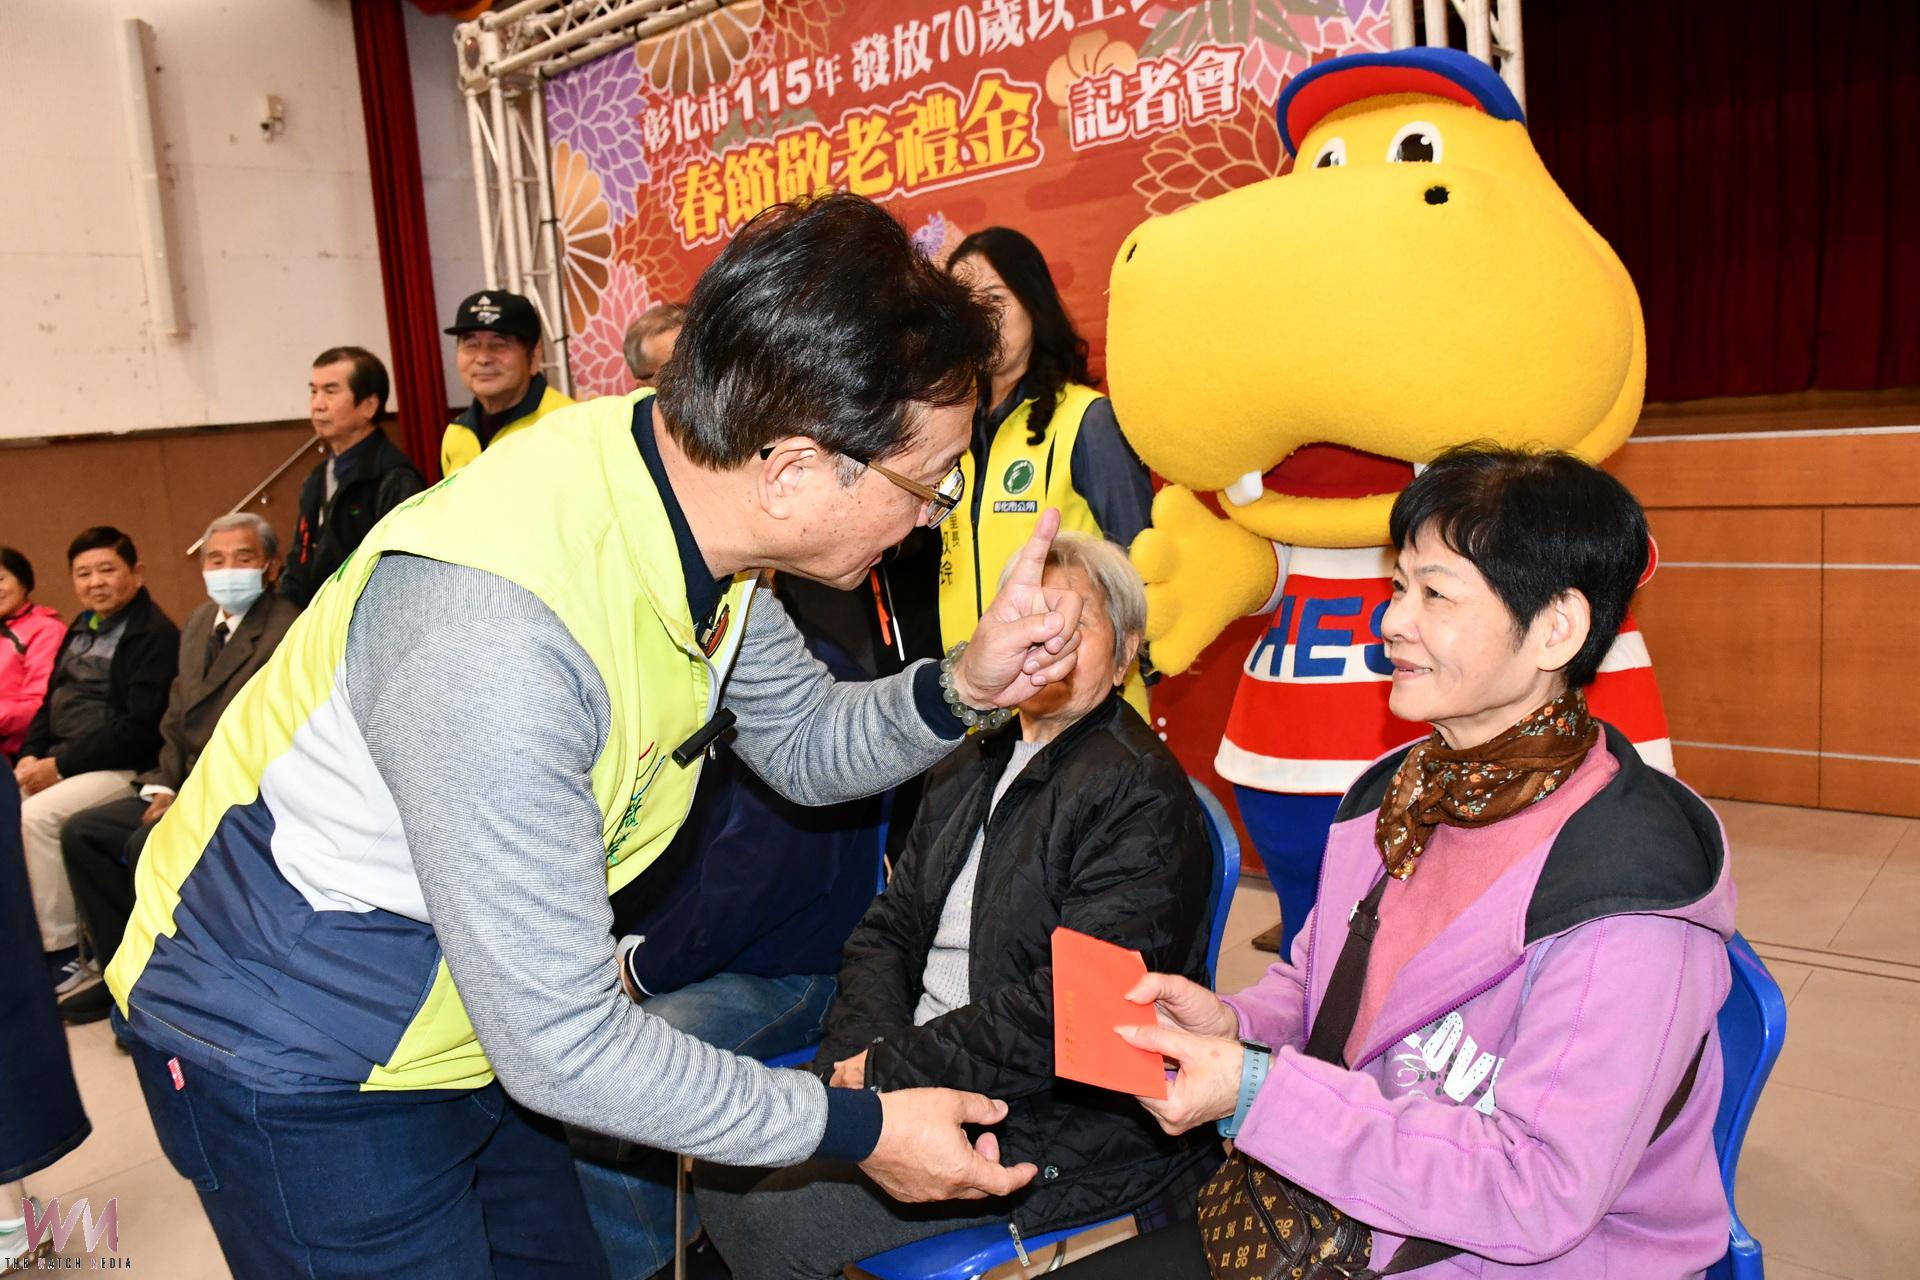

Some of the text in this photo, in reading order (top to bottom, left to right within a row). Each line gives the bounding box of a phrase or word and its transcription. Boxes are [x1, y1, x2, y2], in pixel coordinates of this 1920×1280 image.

[643, 0, 1147, 153] 彰化市115年 發放70歲以上
[675, 49, 1242, 241] 春節敬老禮金 記者會
[994, 501, 1036, 512] 彰化市公所
